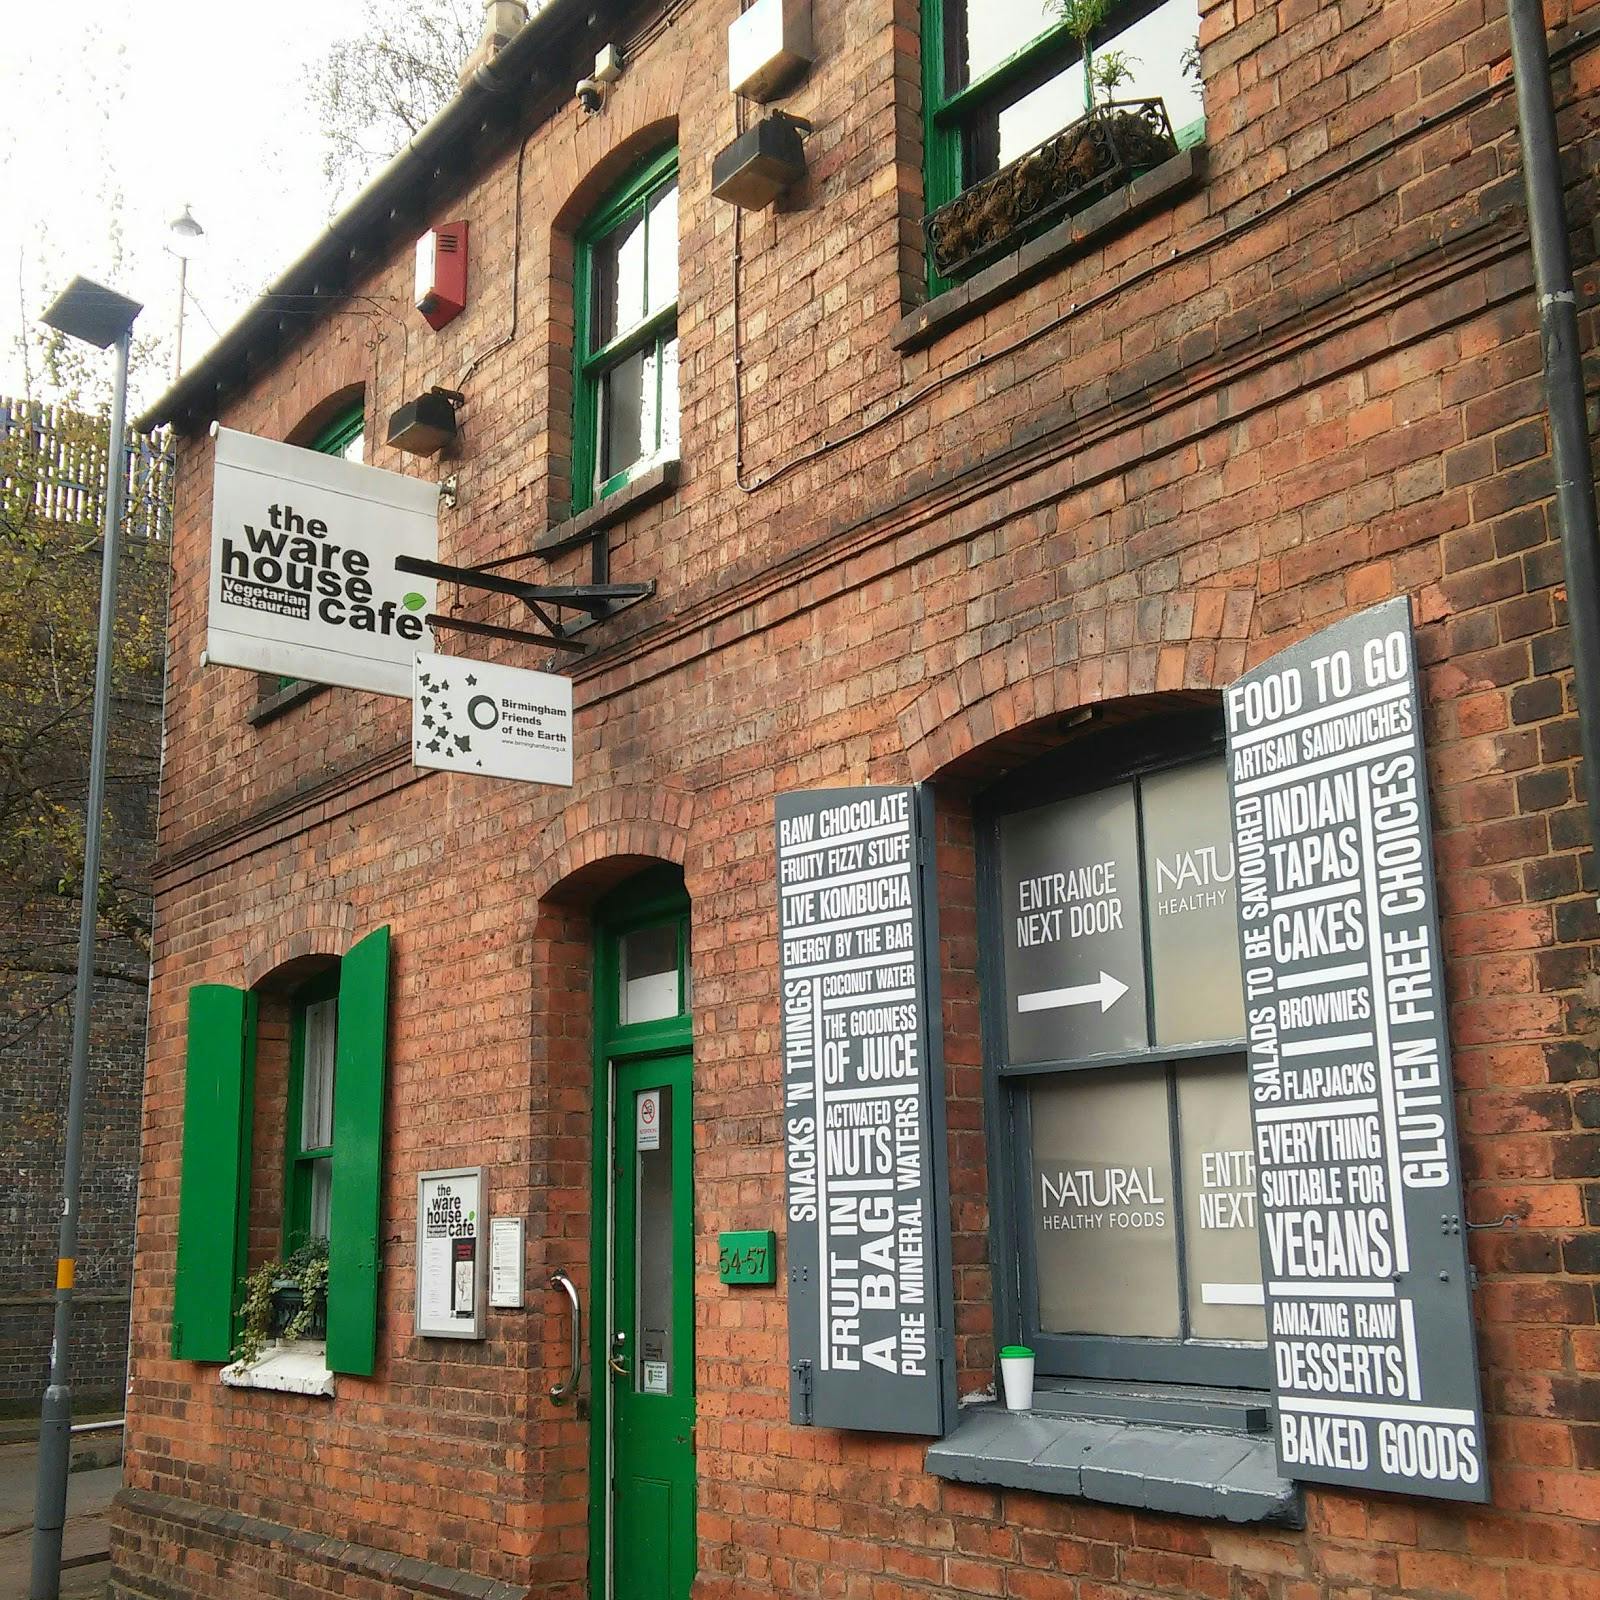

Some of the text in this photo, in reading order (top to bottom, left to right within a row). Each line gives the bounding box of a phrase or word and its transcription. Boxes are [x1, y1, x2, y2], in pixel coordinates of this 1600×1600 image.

[268, 504, 328, 538] the
[221, 538, 372, 603] house
[244, 524, 369, 576] ware
[223, 579, 307, 606] Vegetarian
[223, 590, 308, 618] Restaurant
[319, 598, 422, 640] cafe
[1228, 631, 1408, 732] FOOD TO GO
[502, 698, 566, 716] Birmingham
[502, 712, 542, 725] Friends
[502, 726, 566, 742] of the Earth
[1234, 698, 1412, 782] ARTISAN SANDWICHES
[780, 792, 908, 846] RAW CHOCOLATE
[1264, 771, 1356, 841] INDIAN
[781, 834, 910, 884] FRUITY FIZZY STUFF
[1156, 842, 1236, 894] NATU
[1269, 826, 1360, 892] TAPAS
[783, 875, 912, 926] LIVE KOMBUCHA
[1019, 861, 1117, 912] ENTRANCE
[1158, 890, 1227, 916] HEALTHY
[784, 922, 913, 966] ENERGY BY THE BAR
[1016, 898, 1124, 948] NEXT DOOR
[1273, 898, 1364, 964] CAKES
[1236, 796, 1281, 1102] SALADS TO BE SAVOURED
[1370, 755, 1450, 1188] GLUTEN FREE CHOICES
[823, 964, 915, 996] COCONUT WATER
[824, 1004, 916, 1040] THE GOODNESS
[1278, 986, 1370, 1030] BROWNIES
[824, 1032, 918, 1085] OF JUICE
[1283, 1062, 1376, 1100] FLAPJACKS
[785, 979, 816, 1222] SNACKS 'N THINGS
[826, 1100, 890, 1128] ACTIVATED
[826, 1126, 893, 1176] NUTS
[1257, 1116, 1381, 1165] EVERYTHING
[437, 1184, 451, 1196] the
[1041, 1166, 1164, 1208] NATURAL
[1202, 1150, 1256, 1188] ENTR
[1262, 1165, 1386, 1208] SUITABLE FOR
[427, 1208, 462, 1224] house
[432, 1196, 461, 1210] ware
[1044, 1212, 1165, 1230] HEALTHY FOODS
[1200, 1192, 1257, 1229] NEXT
[448, 1218, 474, 1236] cafe
[894, 1097, 926, 1376] PURE MINERAL WATERS
[1265, 1208, 1392, 1278] VEGANS
[720, 1248, 766, 1274] 54-57
[829, 1196, 860, 1370] FRUIT IN
[859, 1196, 898, 1374] A BAG
[1273, 1302, 1396, 1338] AMAZING RAW
[1274, 1342, 1404, 1396] DESSERTS
[1280, 1414, 1479, 1484] BAKED GOODS
